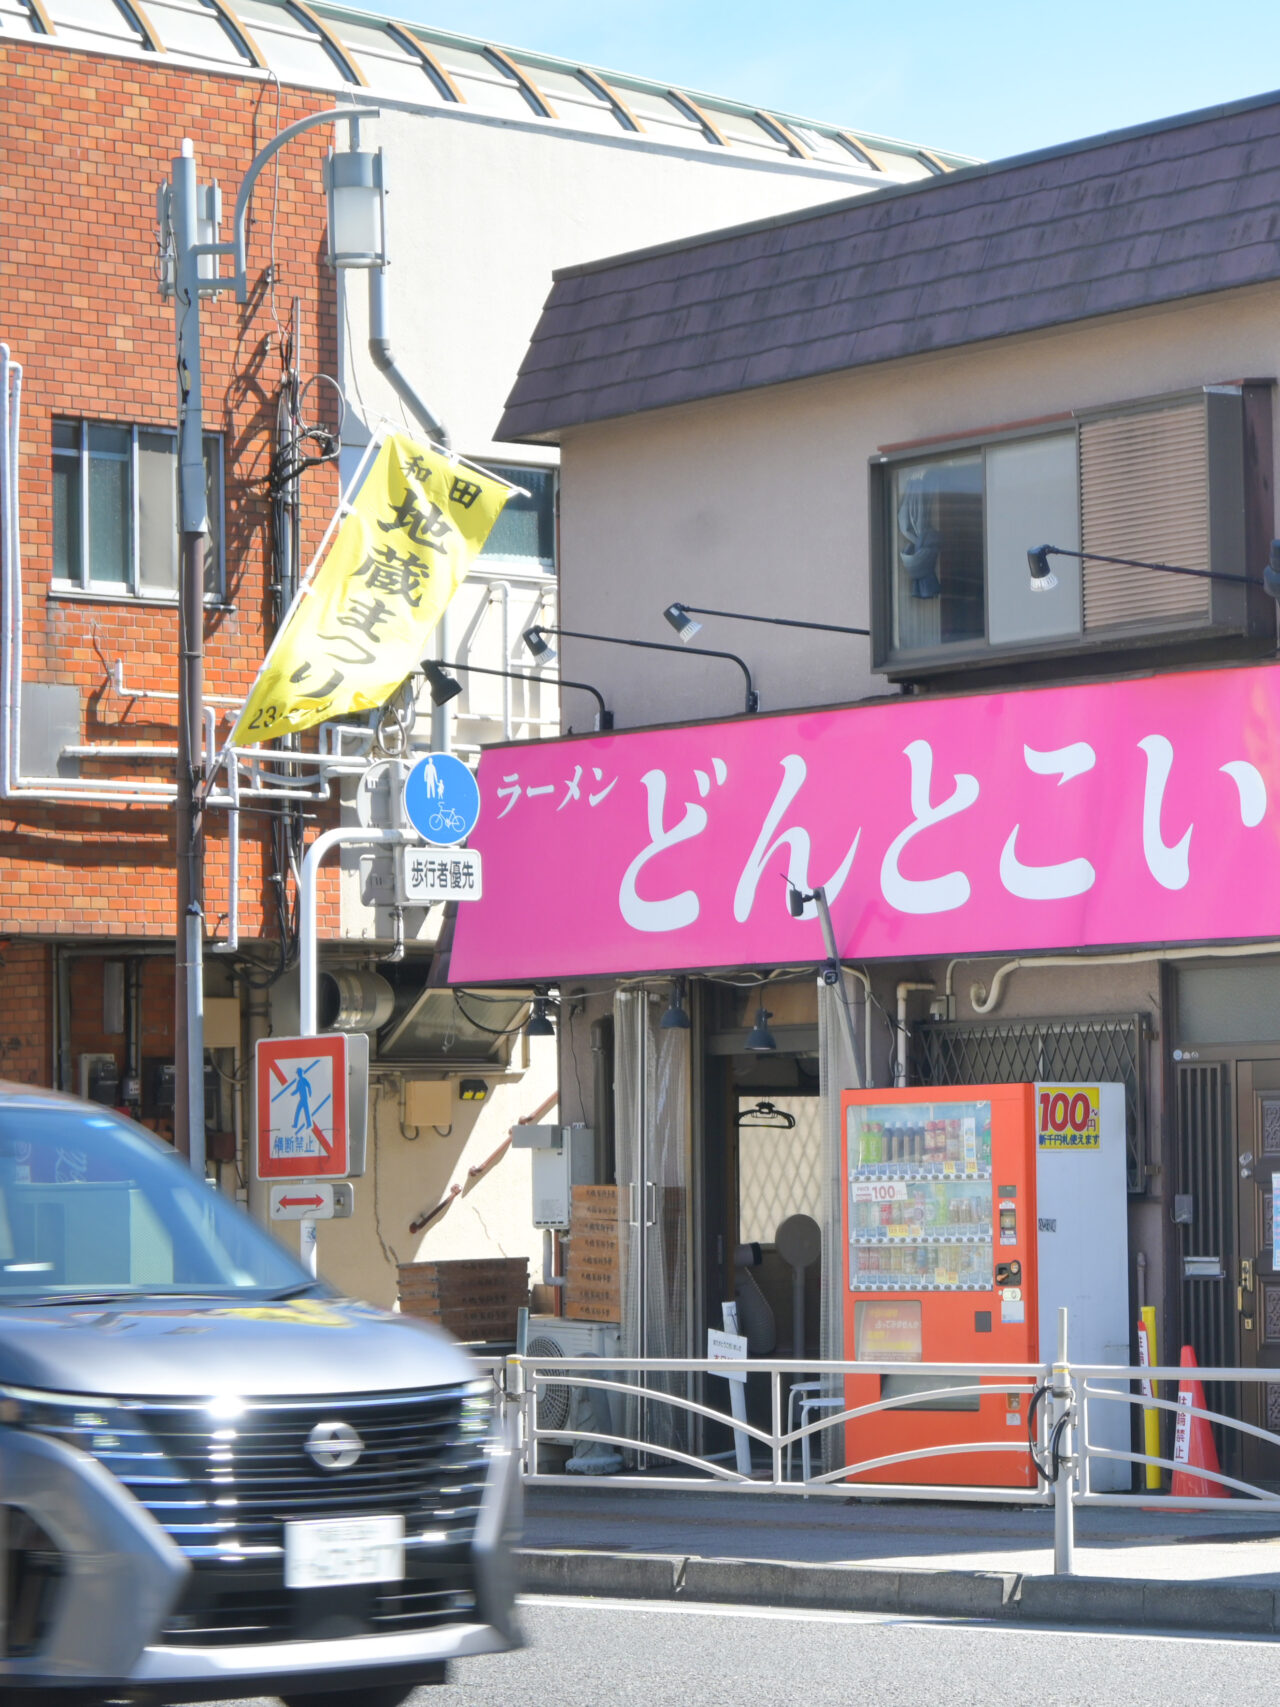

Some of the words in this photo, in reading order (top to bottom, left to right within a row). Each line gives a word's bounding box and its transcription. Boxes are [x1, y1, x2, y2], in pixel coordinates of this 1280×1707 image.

[400, 455, 482, 509] 和田
[289, 487, 453, 698] 地蔵まつり
[497, 764, 619, 819] ラーメン
[411, 859, 475, 889] 歩行者優先
[274, 1135, 316, 1154] 横断禁止
